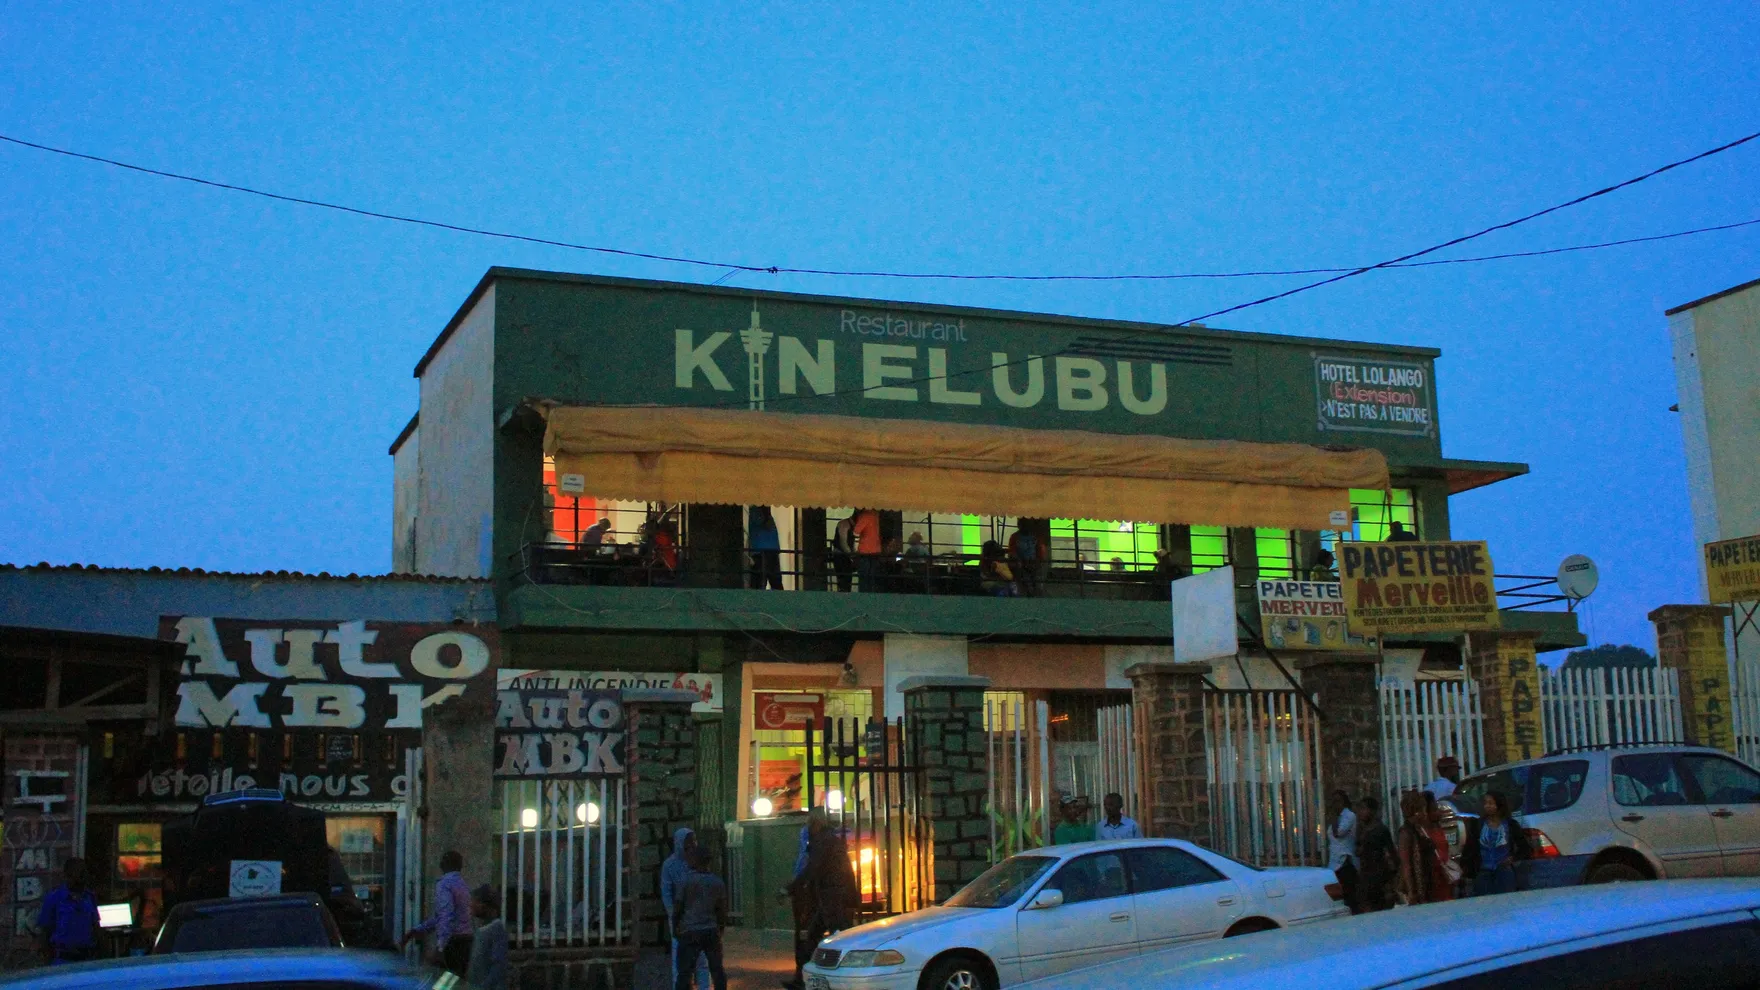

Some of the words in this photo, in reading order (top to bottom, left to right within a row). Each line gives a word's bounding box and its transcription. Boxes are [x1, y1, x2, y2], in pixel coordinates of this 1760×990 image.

[840, 309, 968, 343] Restaurant
[1321, 363, 1360, 383] HOTEL
[1362, 366, 1423, 388] LOLANGO
[1359, 404, 1378, 419] PAS
[1389, 406, 1428, 424] VENDRE
[1342, 545, 1486, 578] PAPETERIE
[1356, 576, 1489, 608] Merveille
[174, 616, 490, 681] Auto
[494, 689, 621, 729] Auto
[493, 730, 625, 776] MBK
[279, 771, 370, 797] nous
